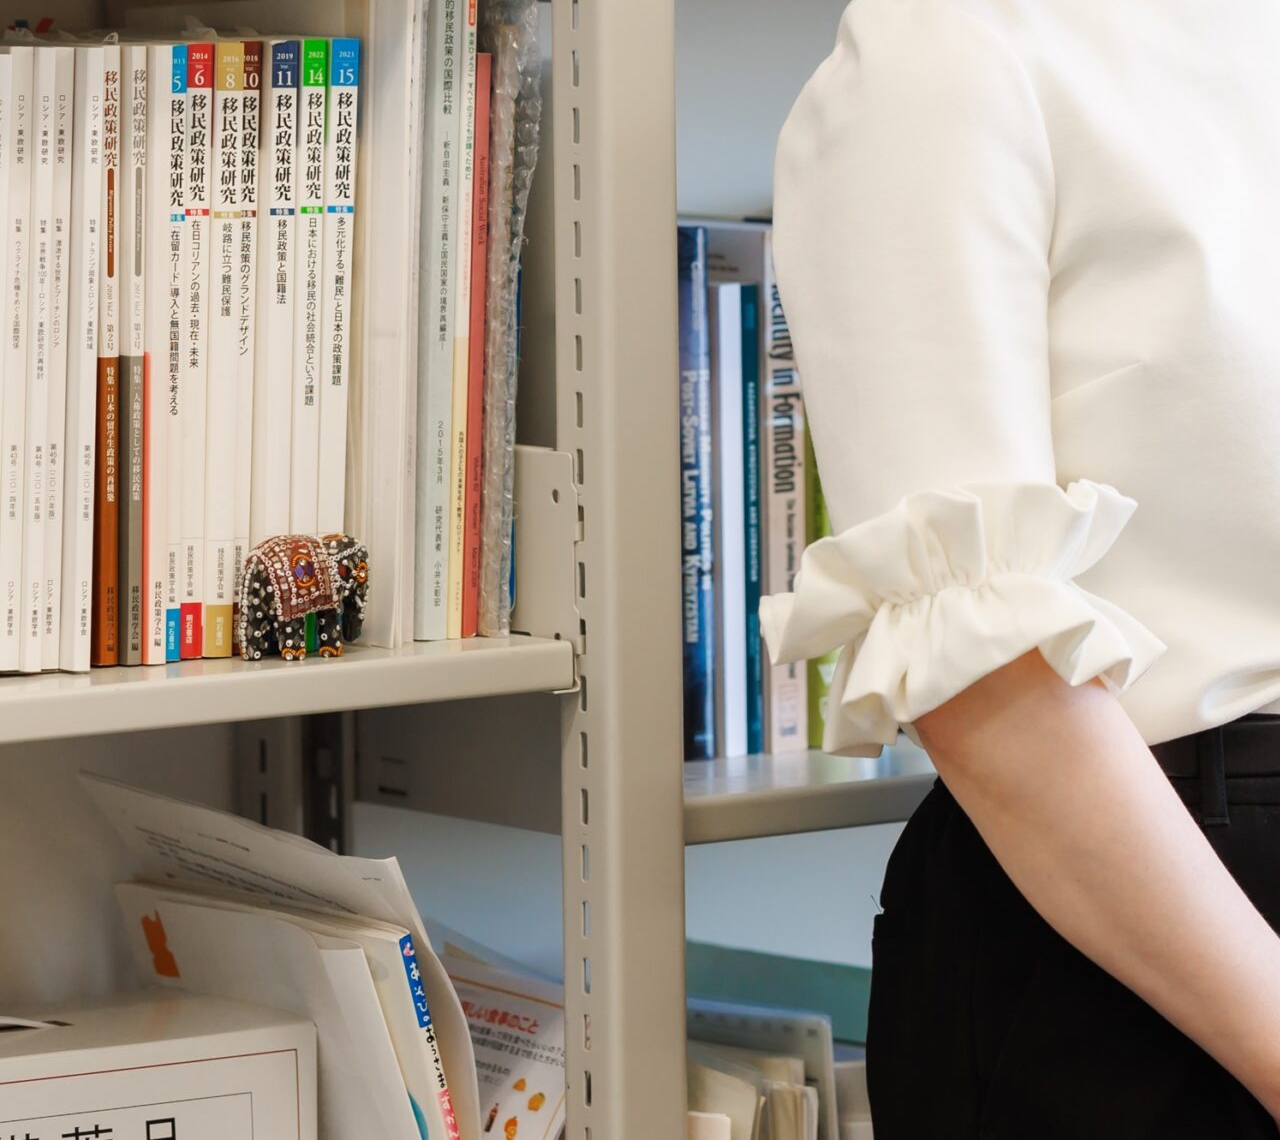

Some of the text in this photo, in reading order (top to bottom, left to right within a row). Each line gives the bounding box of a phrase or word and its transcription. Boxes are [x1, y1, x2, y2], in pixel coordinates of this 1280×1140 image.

[104, 70, 118, 167] 移民政策研究
[133, 69, 146, 166] 移民政策研究
[174, 75, 182, 91] 5
[194, 69, 205, 86] 6
[226, 74, 235, 88] 8
[243, 73, 259, 88] 10
[277, 70, 293, 86] 11
[308, 69, 324, 84] 14
[339, 69, 354, 85] 15
[170, 99, 184, 207] 移民政策研究
[189, 94, 207, 202] 移民政策研究
[220, 97, 238, 205] 移民政策研究
[241, 95, 257, 203] 移民政策研究
[275, 94, 293, 201] 移民政策研究
[305, 92, 323, 200] 移民政策研究
[334, 92, 353, 199] 移民政策研究
[478, 155, 487, 246] Australian Social Work
[189, 220, 201, 368] 在日コリアンの過去・現在・未来
[220, 223, 233, 317] 岐路に立つ難民保護
[239, 221, 252, 356] 移民政策のグランドデザイン
[276, 219, 287, 305] 移民政策と国籍法
[304, 217, 318, 406] 日本における移民の社会統合という課題
[773, 367, 799, 386] in
[774, 392, 801, 494] Formation
[154, 581, 162, 636] 移民政策学会
